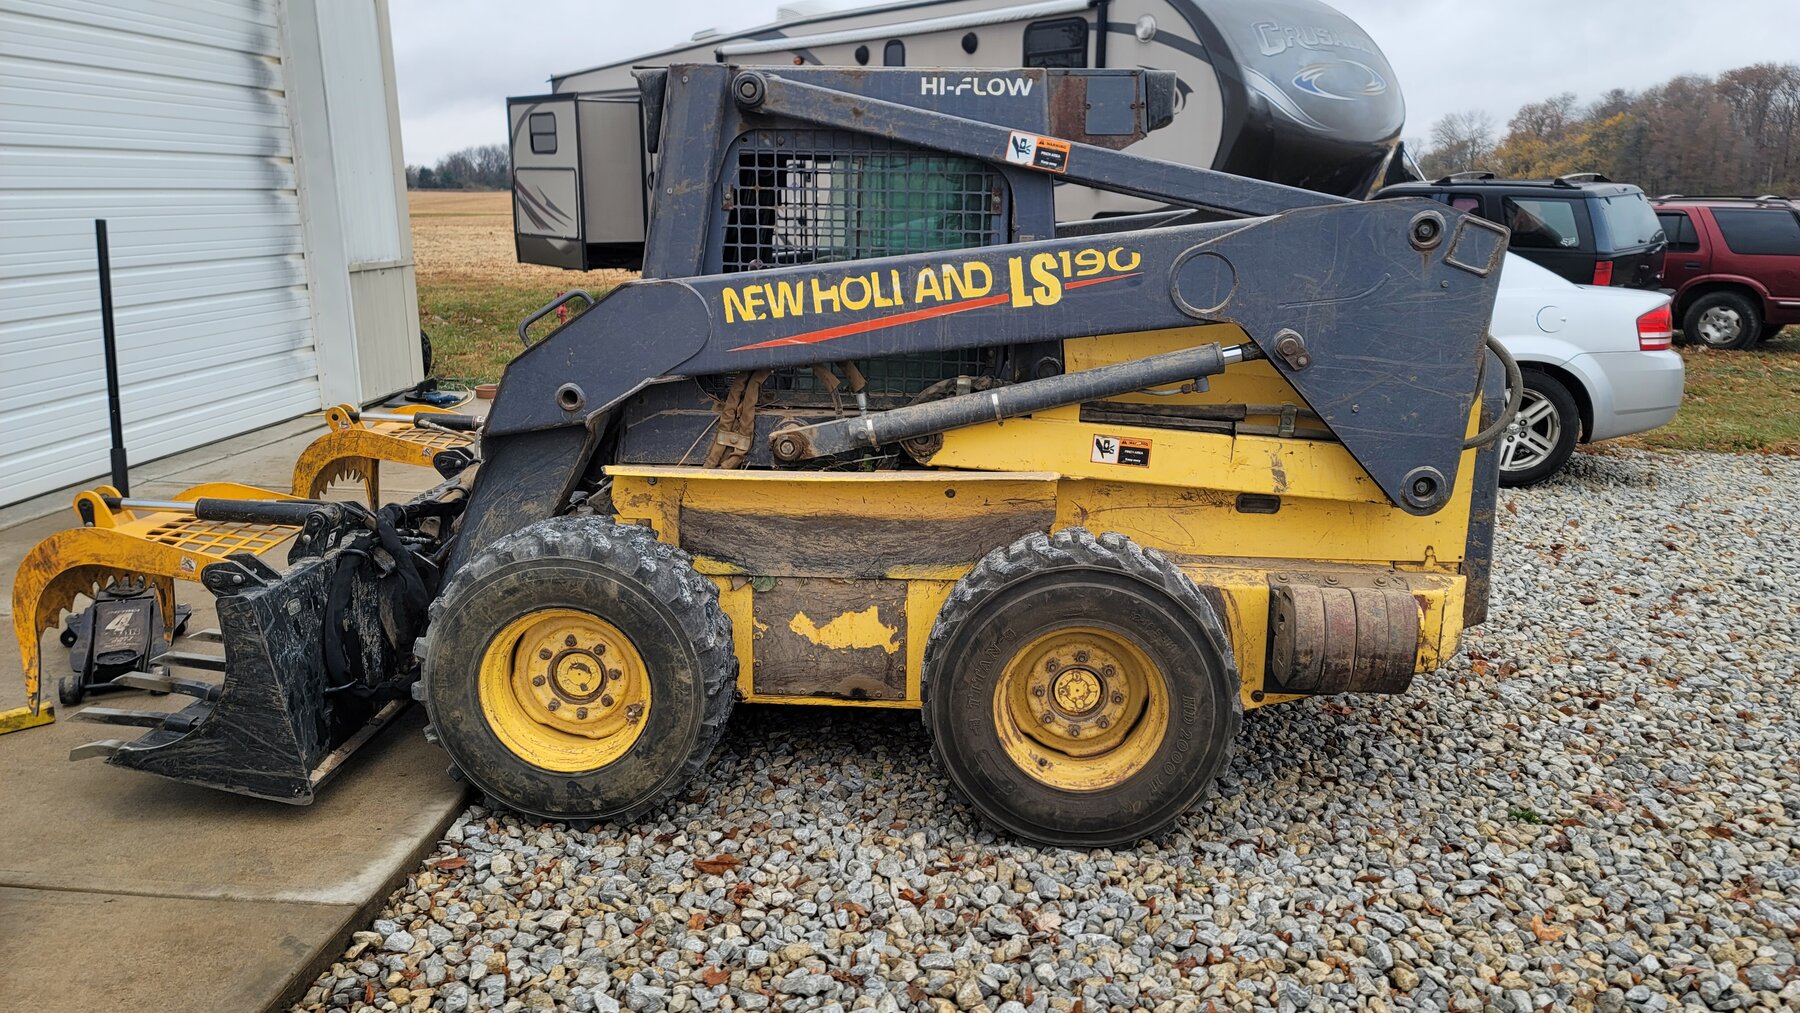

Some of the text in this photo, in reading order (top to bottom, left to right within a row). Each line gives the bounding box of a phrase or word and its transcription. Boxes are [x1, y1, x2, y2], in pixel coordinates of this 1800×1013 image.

[1250, 20, 1377, 56] CRUSA
[921, 77, 1033, 96] HI-FLOW
[723, 281, 804, 324] NEW
[811, 261, 993, 315] HOLLAND
[105, 612, 133, 632] 4
[966, 641, 1002, 709] TITAN
